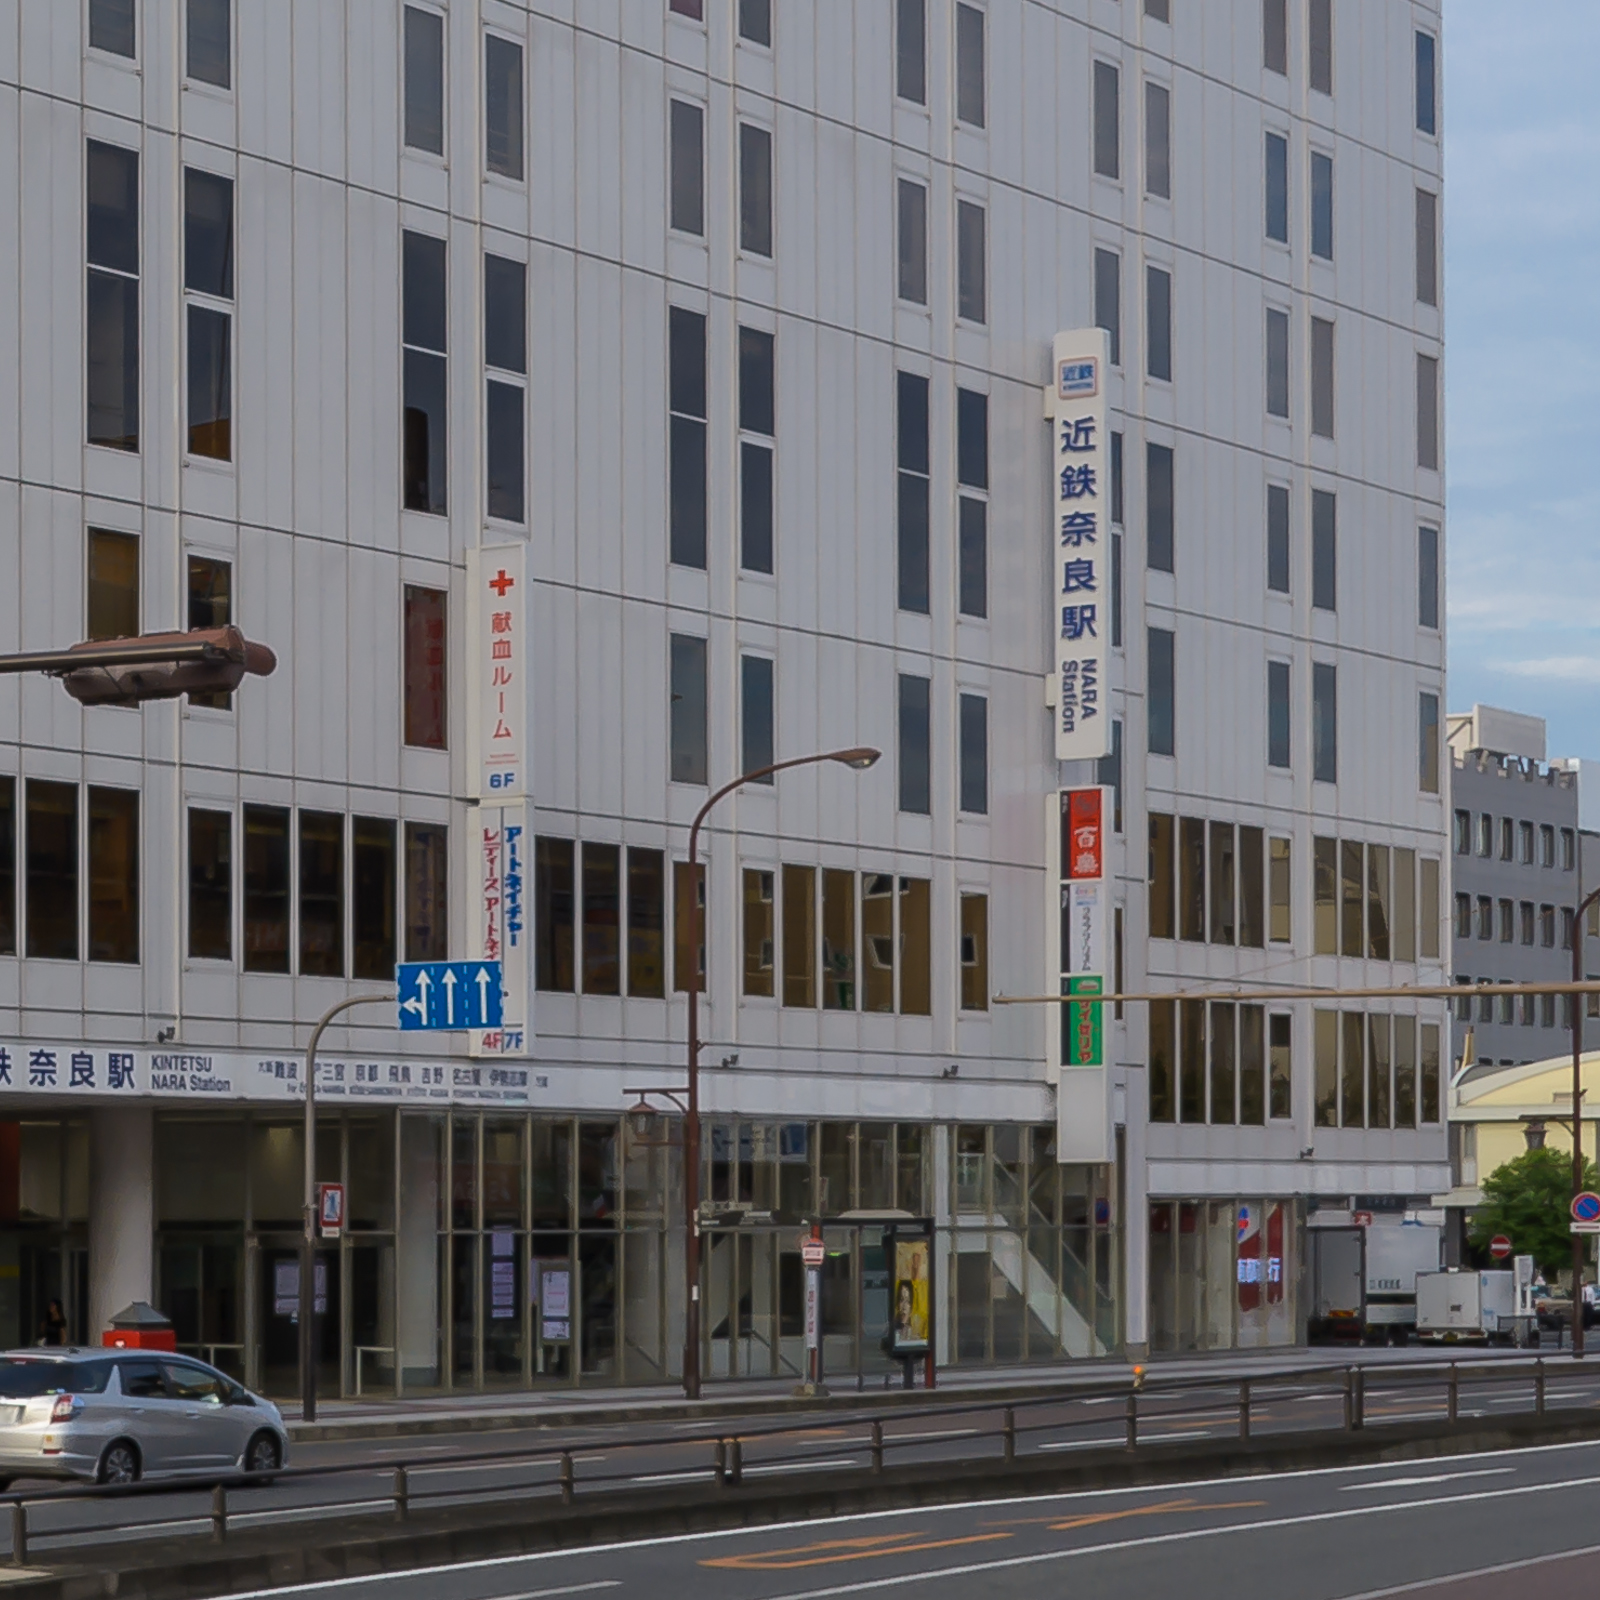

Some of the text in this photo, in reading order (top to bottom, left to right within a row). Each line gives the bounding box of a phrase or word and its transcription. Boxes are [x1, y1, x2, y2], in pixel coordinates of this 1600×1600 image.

[1061, 416, 1097, 639] 近鉄奈良駅
[491, 611, 513, 739] 献血ルーム
[1081, 659, 1098, 720] NARA
[1062, 660, 1079, 734] Station
[489, 773, 515, 789] 6F
[483, 828, 501, 893] レディース
[504, 826, 523, 947] アートネイチャー
[482, 1031, 502, 1049] 4F
[504, 1031, 524, 1049] 7F
[151, 1055, 212, 1074] KINTETSU
[151, 1073, 231, 1093] NARA Station
[355, 1064, 379, 1082] 京都
